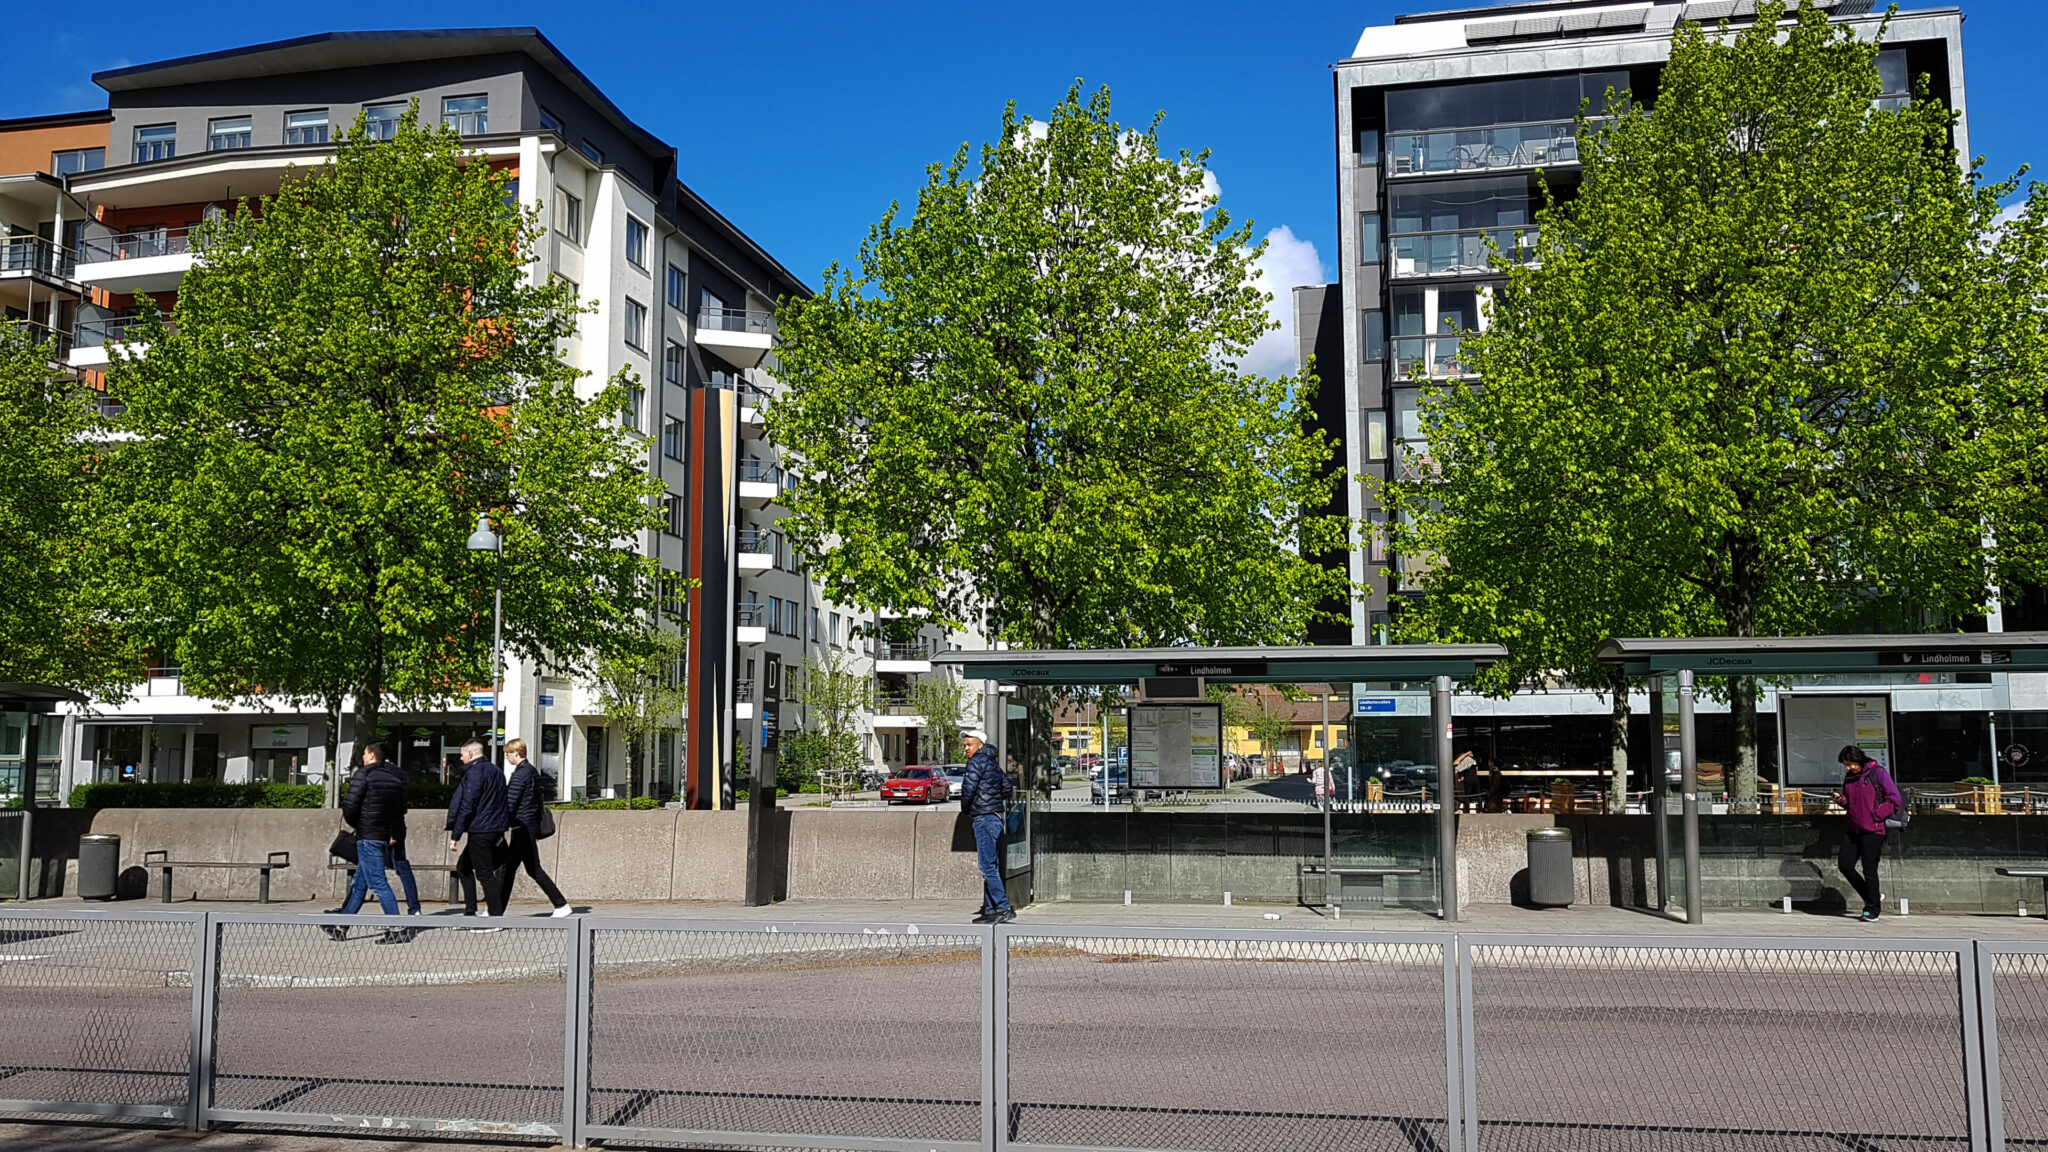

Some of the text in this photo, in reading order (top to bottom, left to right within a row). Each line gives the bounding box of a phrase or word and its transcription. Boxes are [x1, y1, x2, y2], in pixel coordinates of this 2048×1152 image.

[1706, 657, 1753, 665] JCDecaux
[1921, 653, 1970, 663] Lindholmen
[769, 660, 777, 689] D
[1190, 666, 1232, 675] Lindholmen
